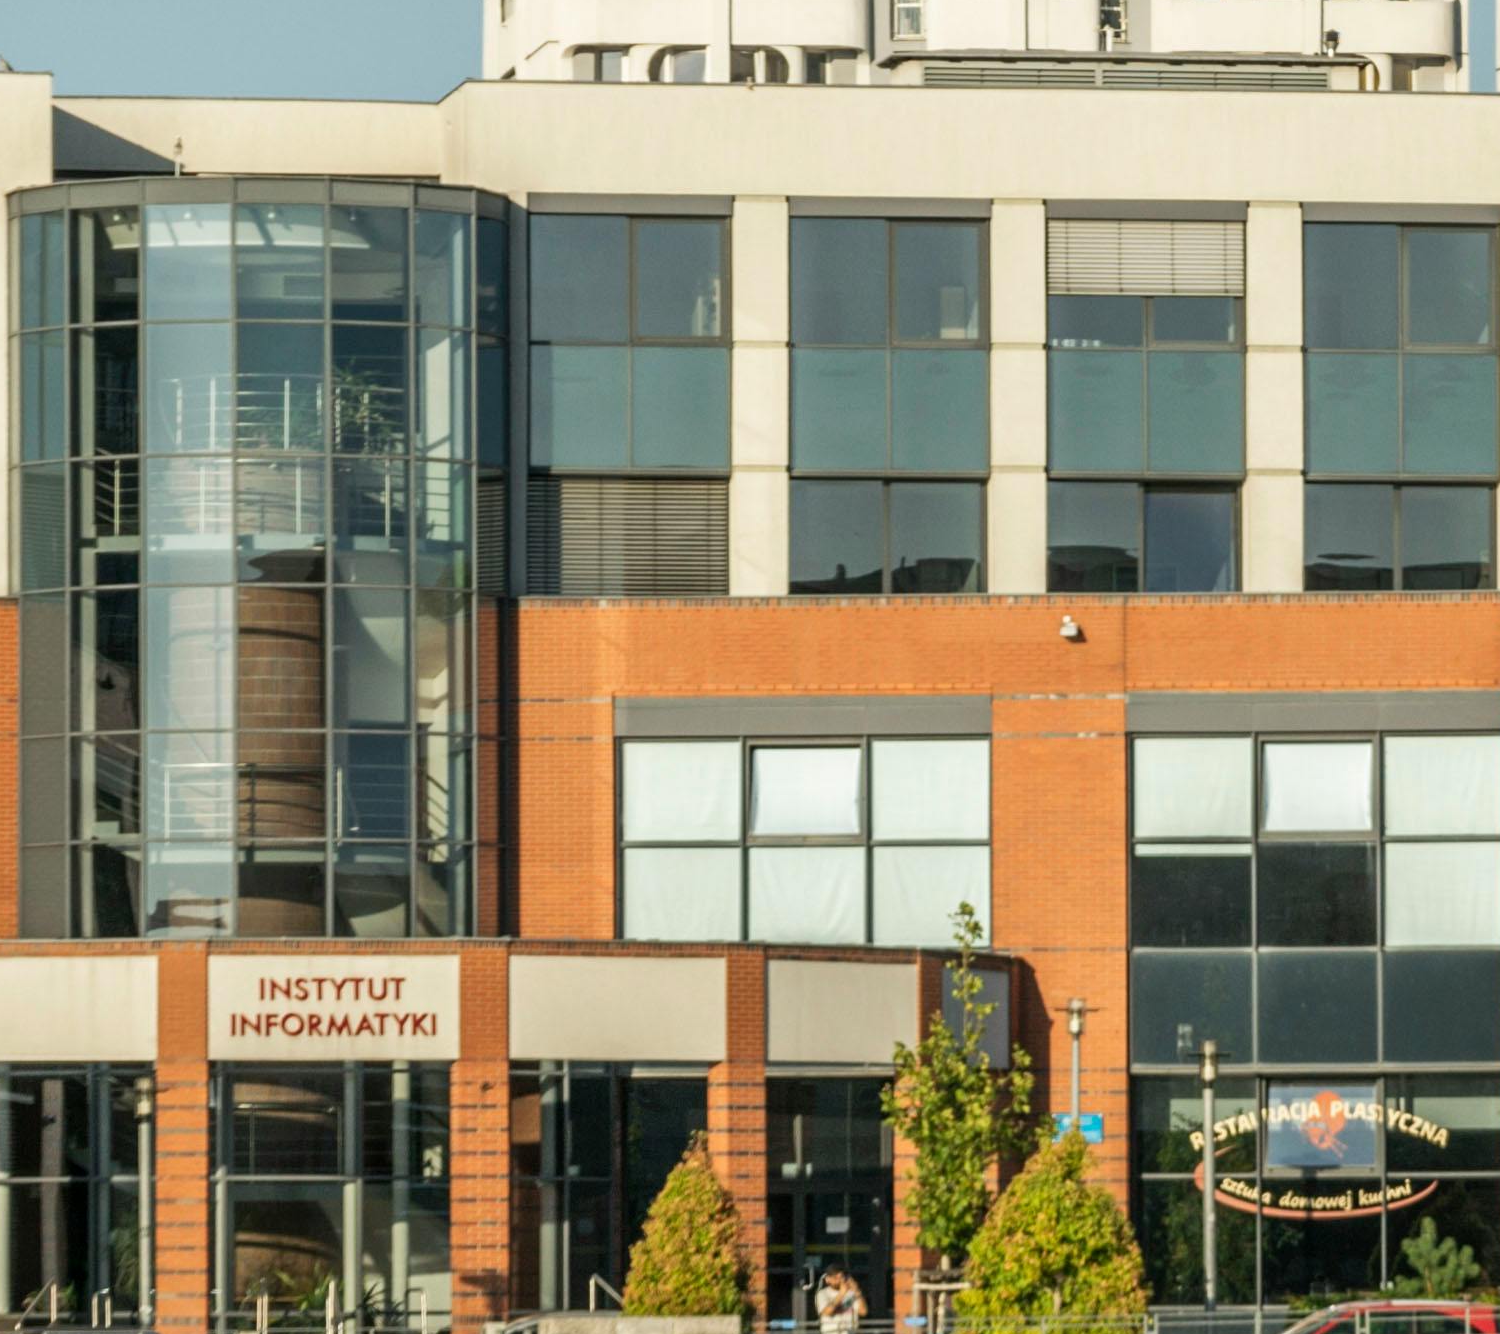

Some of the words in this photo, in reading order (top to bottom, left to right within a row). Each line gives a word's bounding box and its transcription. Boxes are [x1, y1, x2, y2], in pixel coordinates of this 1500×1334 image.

[259, 977, 406, 1001] INSTYTUT
[230, 1013, 438, 1037] INFORMATYKI
[1189, 1100, 1321, 1151] RSTARACJA
